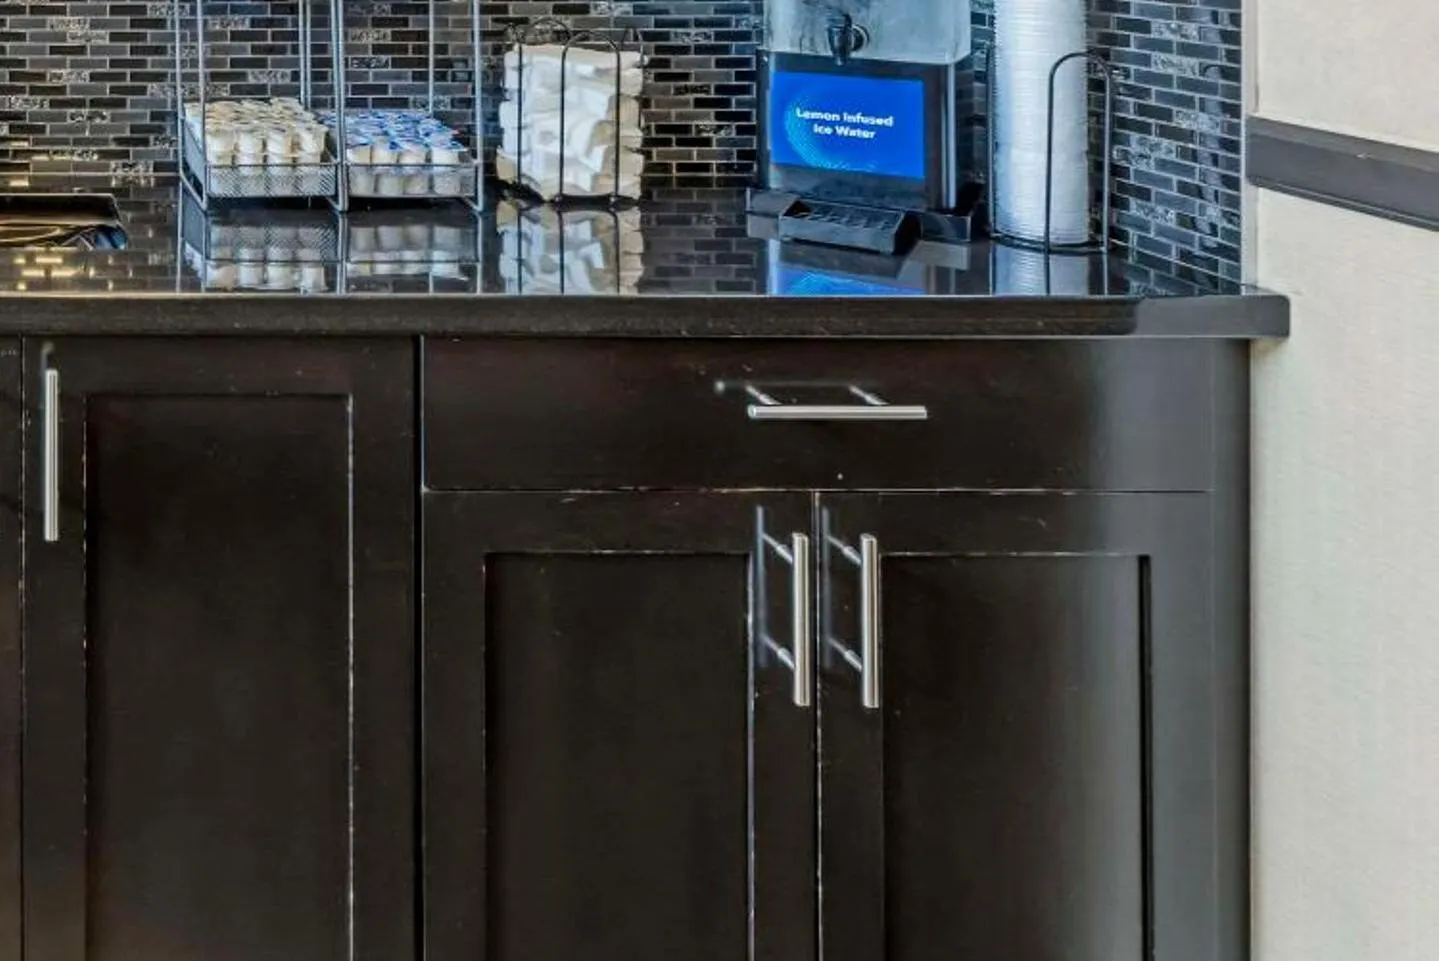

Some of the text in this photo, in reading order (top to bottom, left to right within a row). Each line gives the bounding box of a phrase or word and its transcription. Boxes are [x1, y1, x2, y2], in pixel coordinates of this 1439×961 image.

[795, 106, 894, 128] Lemon Infused
[812, 123, 877, 139] Ice Water
